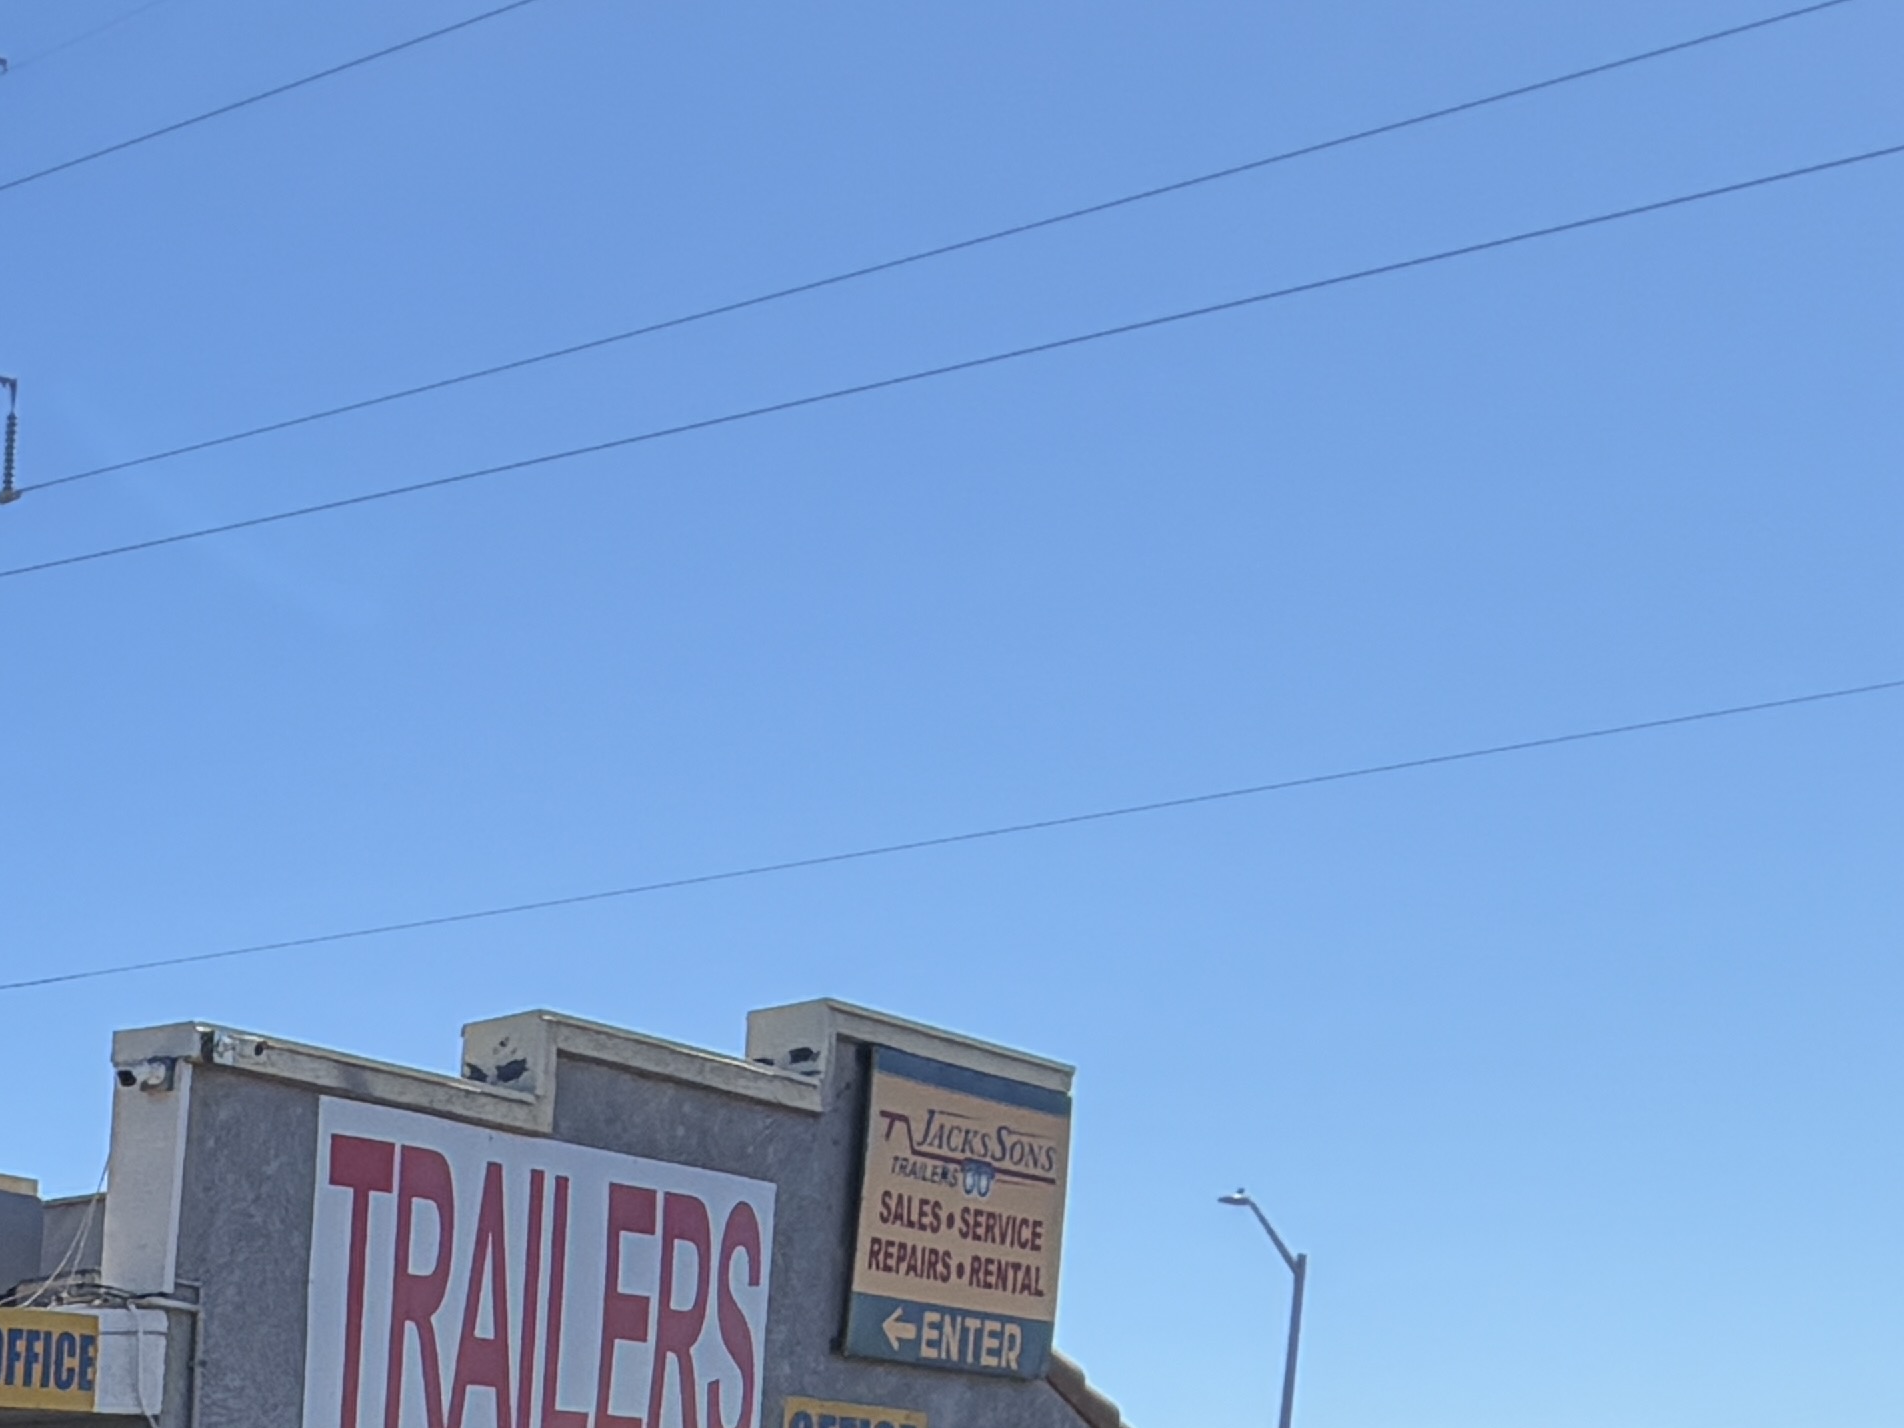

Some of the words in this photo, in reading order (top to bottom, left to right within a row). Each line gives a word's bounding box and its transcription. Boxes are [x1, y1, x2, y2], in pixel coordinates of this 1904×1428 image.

[891, 1156, 958, 1187] TRAILERS
[879, 1190, 942, 1234] SALES
[958, 1206, 1044, 1252] SERVICE
[867, 1236, 952, 1283] REPAIRS
[968, 1254, 1045, 1297] RENTAL
[919, 1310, 1022, 1371] ENTER
